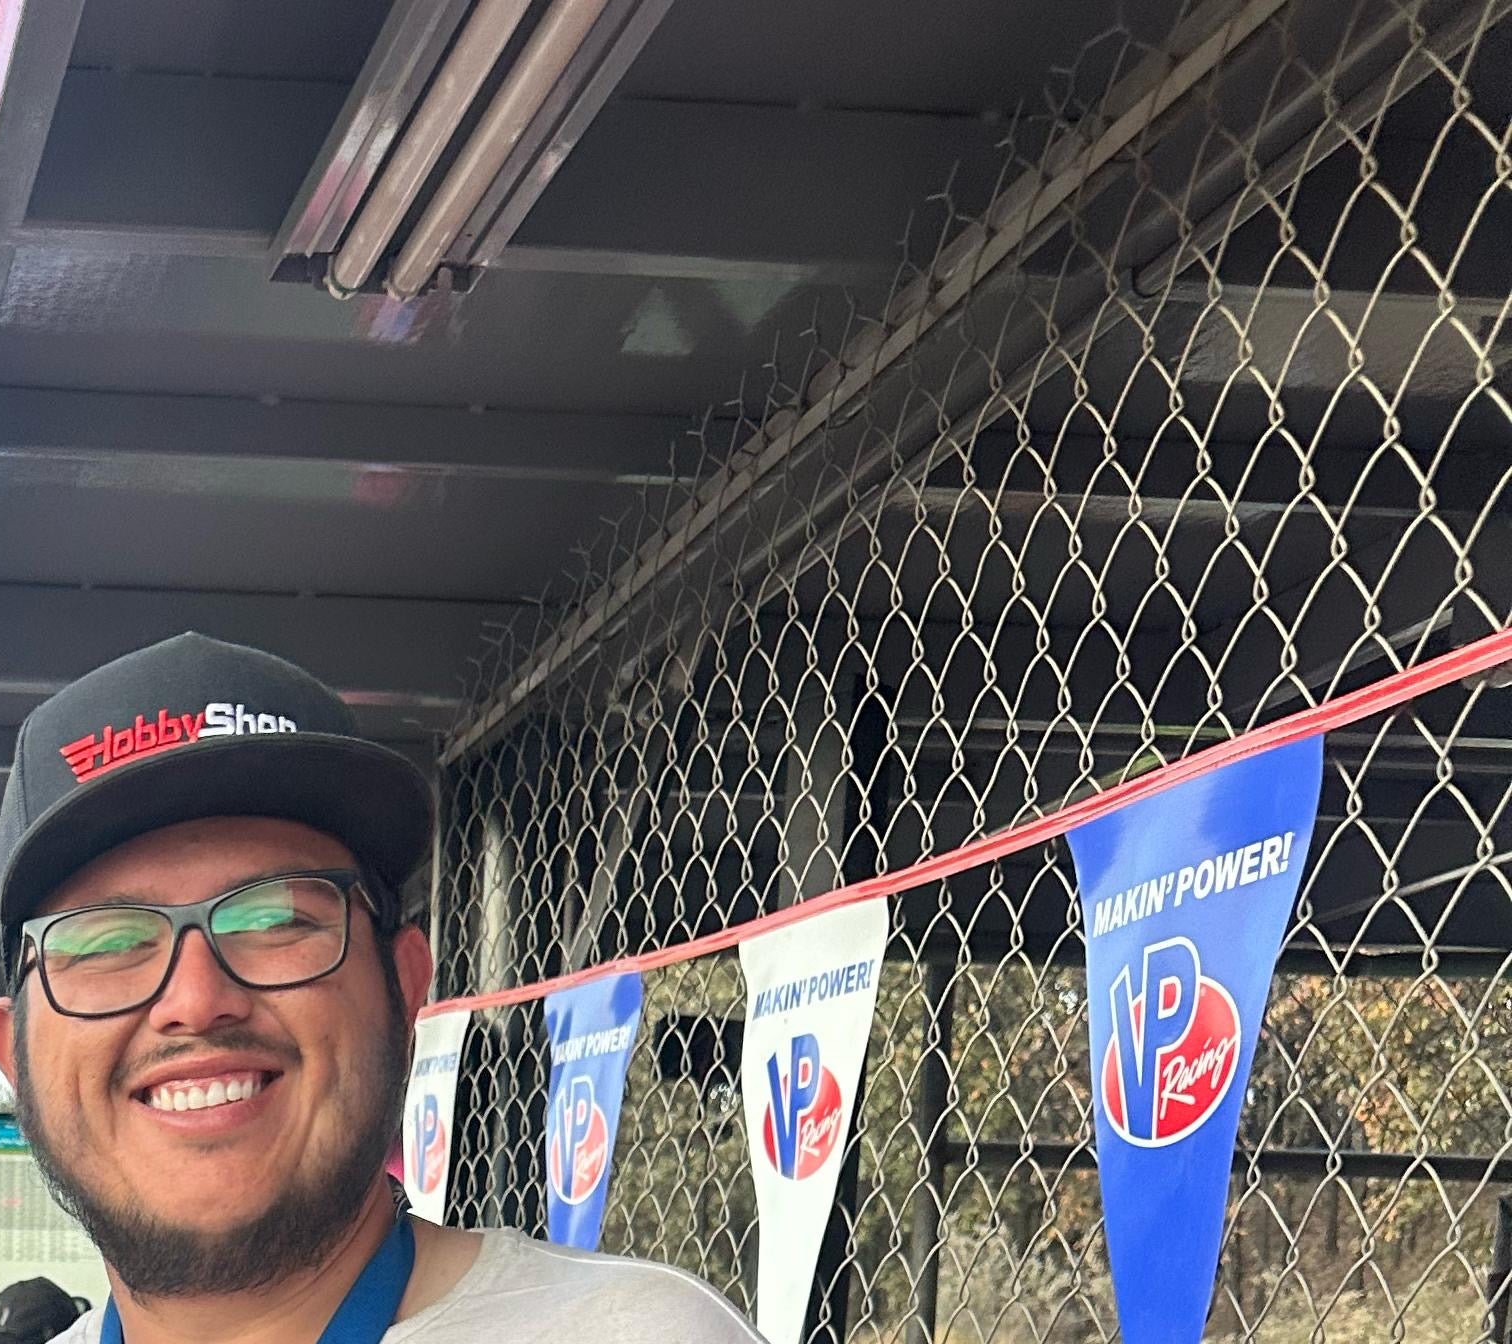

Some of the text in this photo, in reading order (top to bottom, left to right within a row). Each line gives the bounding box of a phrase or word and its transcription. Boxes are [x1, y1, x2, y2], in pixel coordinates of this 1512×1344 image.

[1093, 831, 1295, 938] MAKIN' POWER!
[807, 959, 876, 1006] POWER!
[1109, 936, 1201, 1141] VP
[1159, 1036, 1237, 1121] Racing
[767, 1033, 819, 1180] VP
